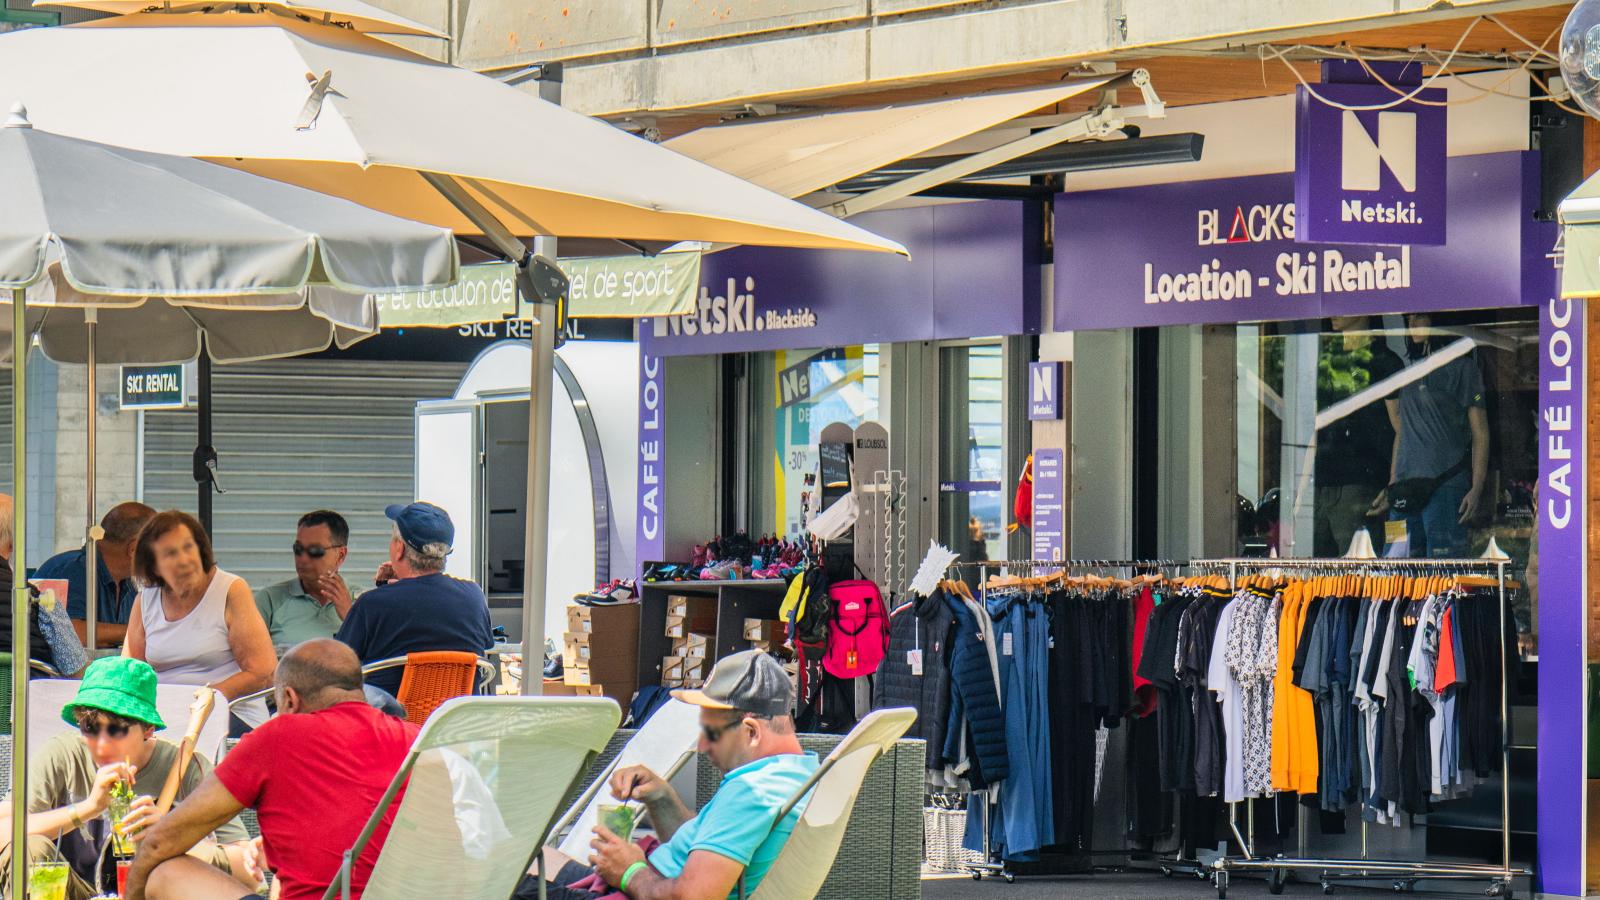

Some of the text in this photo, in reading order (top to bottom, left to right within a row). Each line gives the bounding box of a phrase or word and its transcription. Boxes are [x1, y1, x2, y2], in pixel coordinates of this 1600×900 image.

[1341, 110, 1417, 192] N
[1341, 199, 1423, 224] Netski.
[491, 271, 513, 304] de
[593, 264, 618, 297] de
[621, 261, 675, 305] sport
[1144, 258, 1251, 304] Location
[1276, 251, 1317, 295] Ski
[1323, 244, 1411, 293] Rental
[766, 307, 817, 330] Blackside
[127, 372, 179, 394] SKI RENTAL
[798, 406, 858, 423] DESTOCKAG
[865, 439, 887, 449] LOUBSOL
[1544, 405, 1572, 530] CAFÉ
[640, 440, 658, 541] CAFÉ
